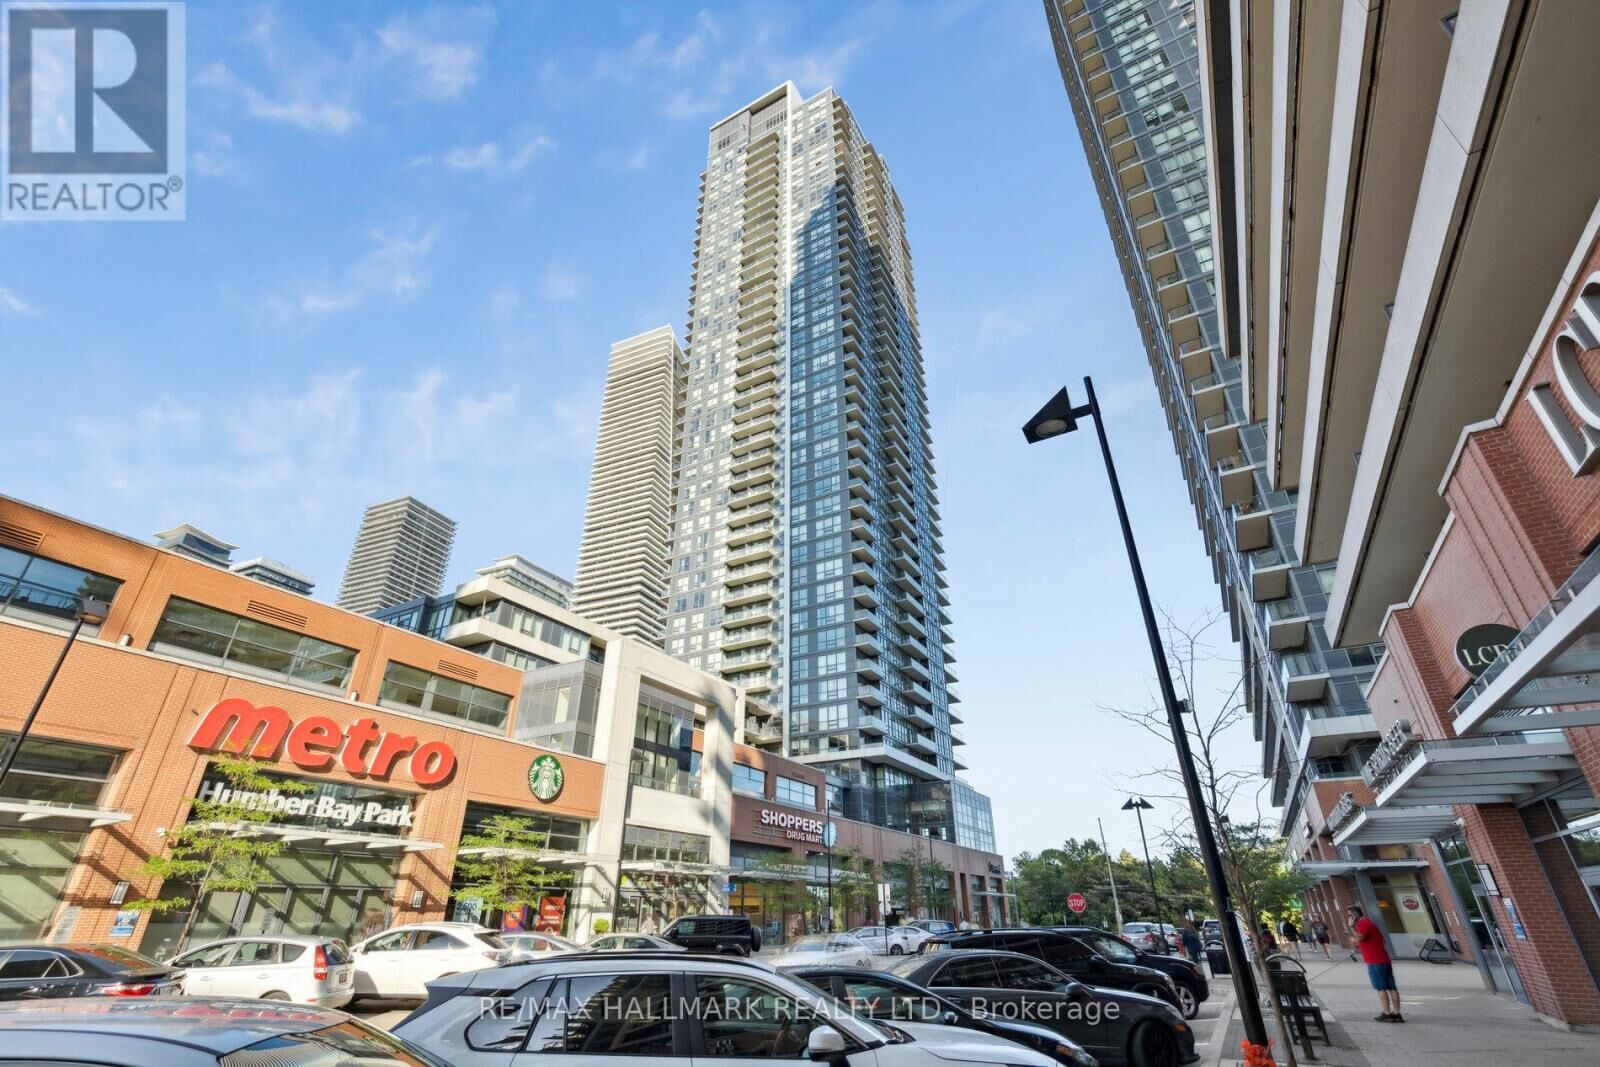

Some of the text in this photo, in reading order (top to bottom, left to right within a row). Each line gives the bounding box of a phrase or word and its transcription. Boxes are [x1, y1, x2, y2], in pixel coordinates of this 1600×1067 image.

[188, 697, 456, 785] metro
[200, 780, 413, 827] Humber Bay Park
[761, 809, 823, 834] SHOPPERS
[786, 830, 824, 844] DRUG MART
[1069, 899, 1085, 907] STOP
